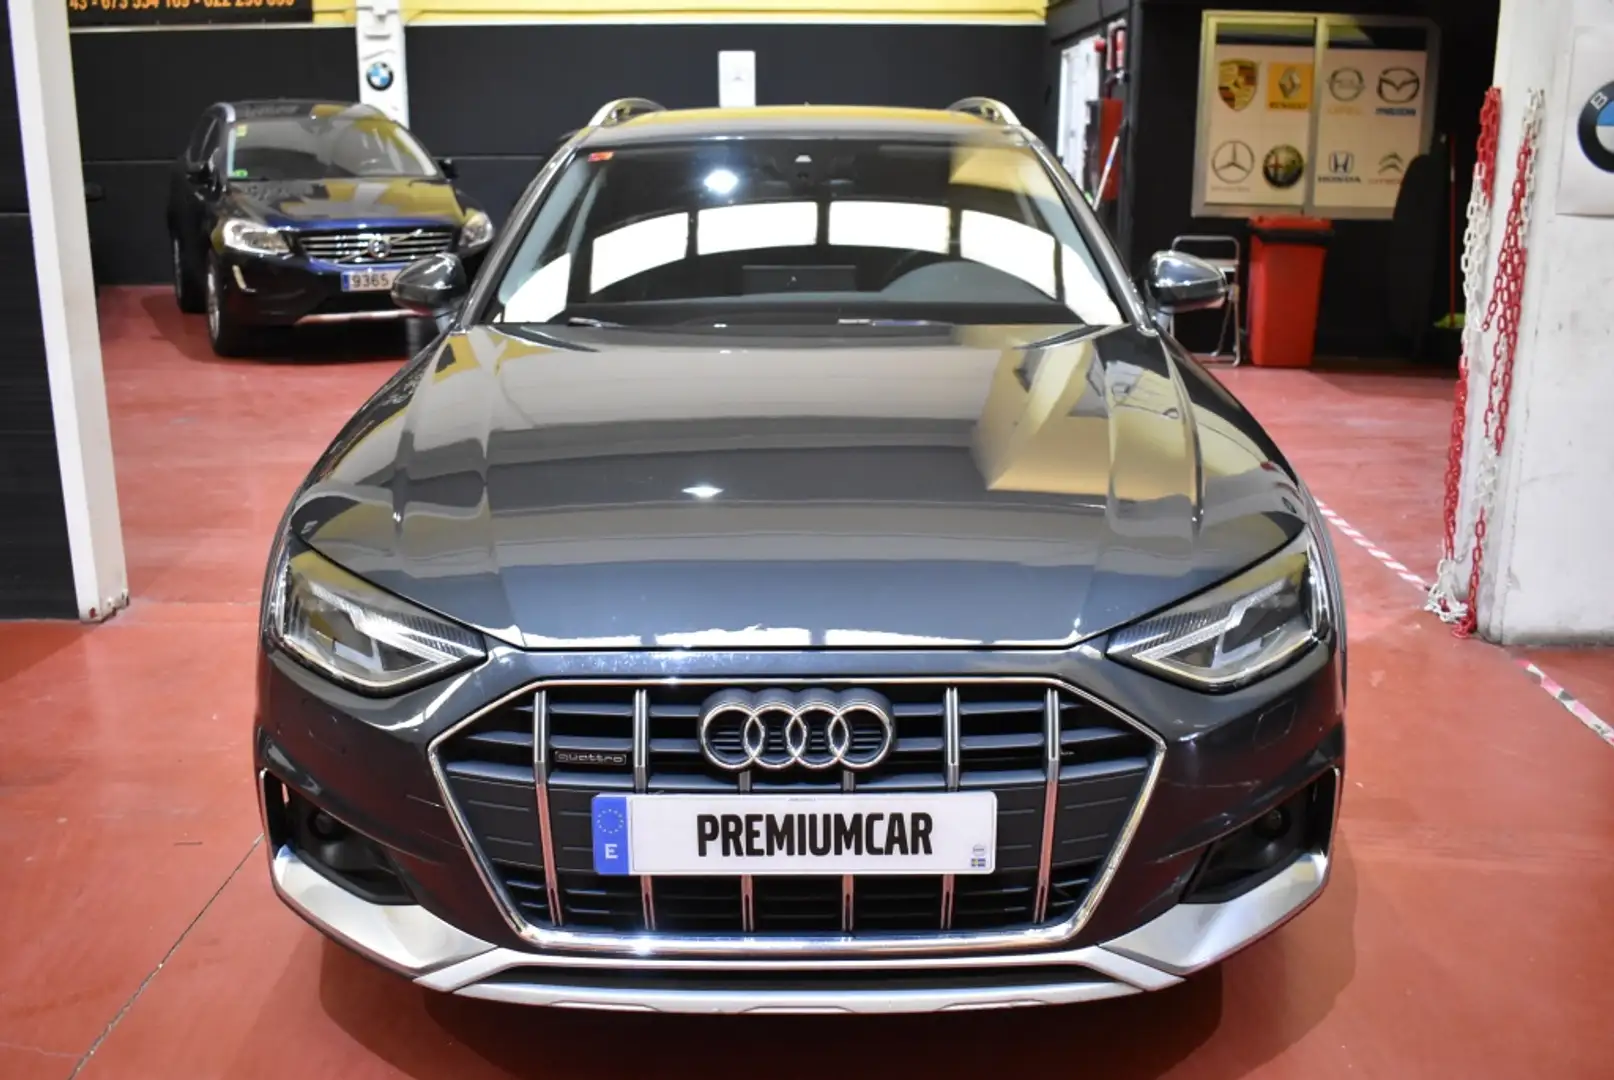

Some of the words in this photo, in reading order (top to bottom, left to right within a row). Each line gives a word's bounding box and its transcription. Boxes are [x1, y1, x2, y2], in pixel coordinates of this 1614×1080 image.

[351, 273, 389, 288] 9365
[558, 753, 624, 763] quattro
[697, 812, 933, 857] PREMIUMCAR
[604, 843, 619, 860] E
